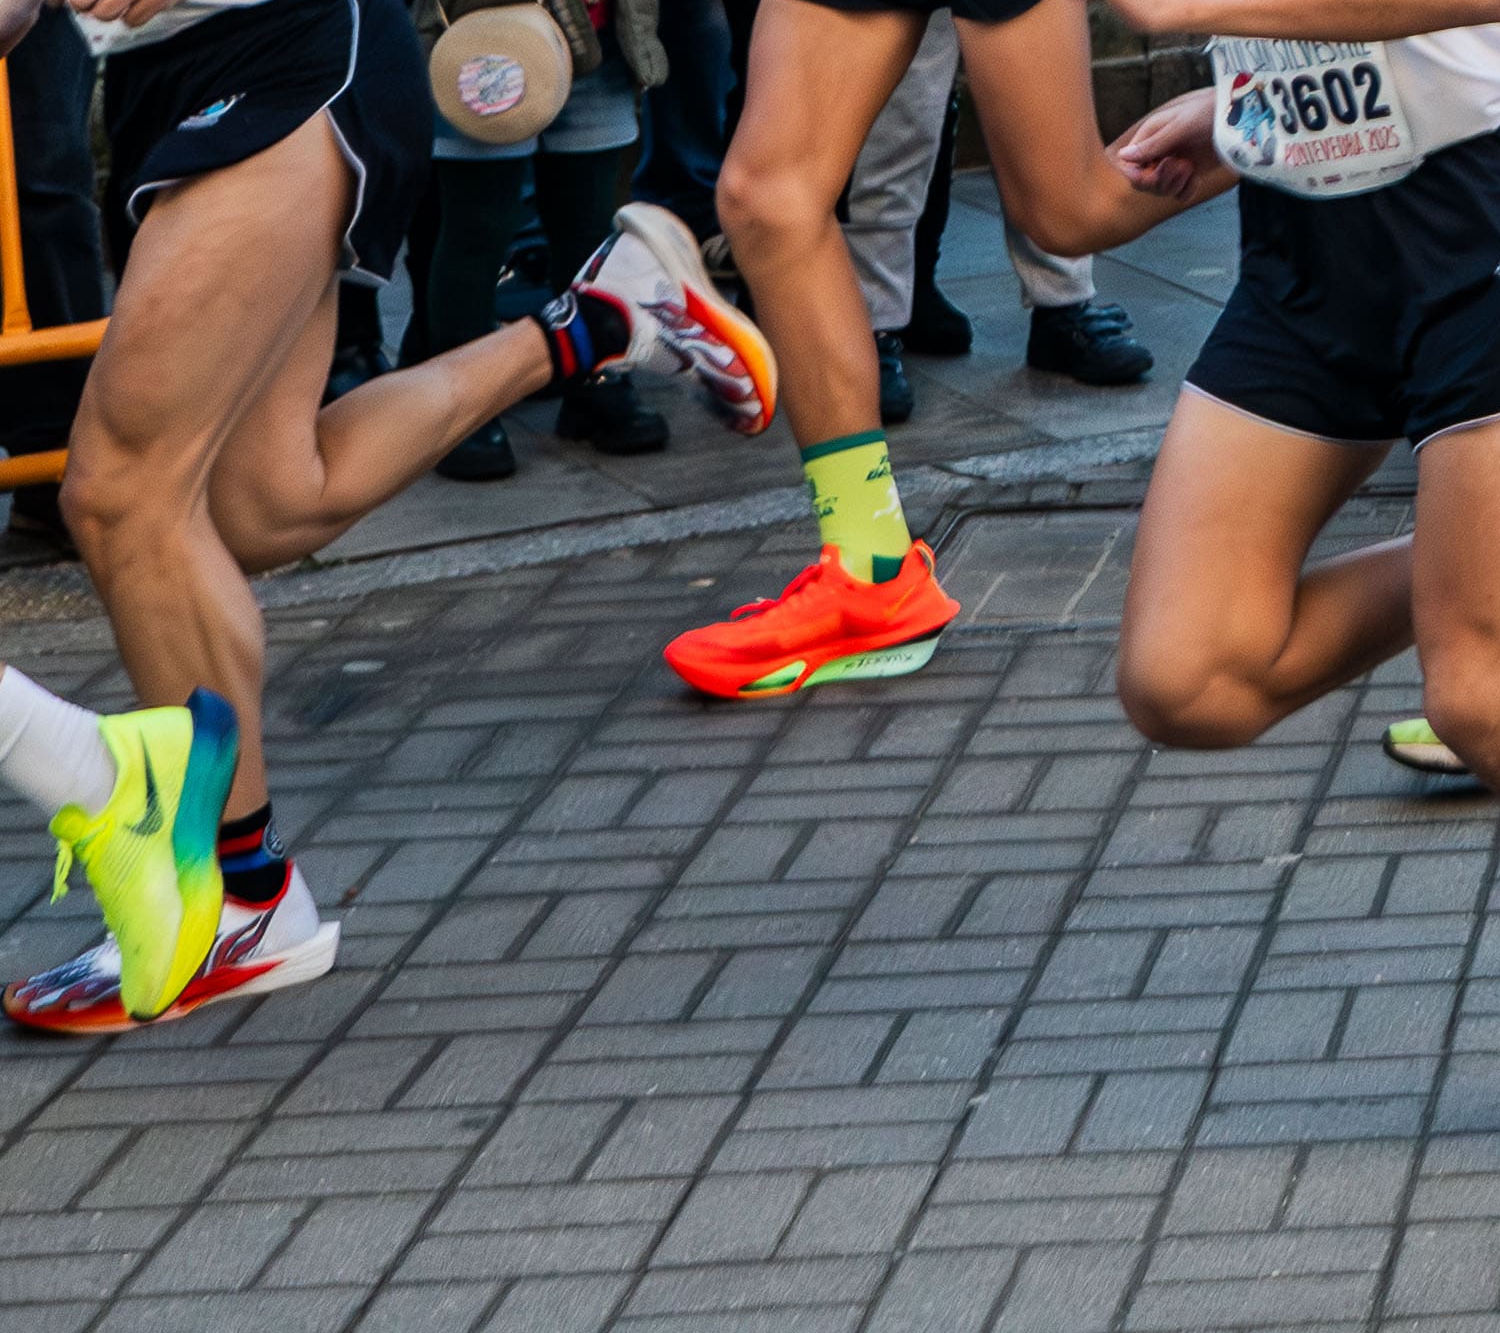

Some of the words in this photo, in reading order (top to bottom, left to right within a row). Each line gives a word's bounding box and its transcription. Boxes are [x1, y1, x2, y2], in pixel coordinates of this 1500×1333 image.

[1270, 60, 1392, 135] 3602
[1283, 130, 1366, 168] PONTEVEDRA
[1366, 124, 1401, 152] 2025
